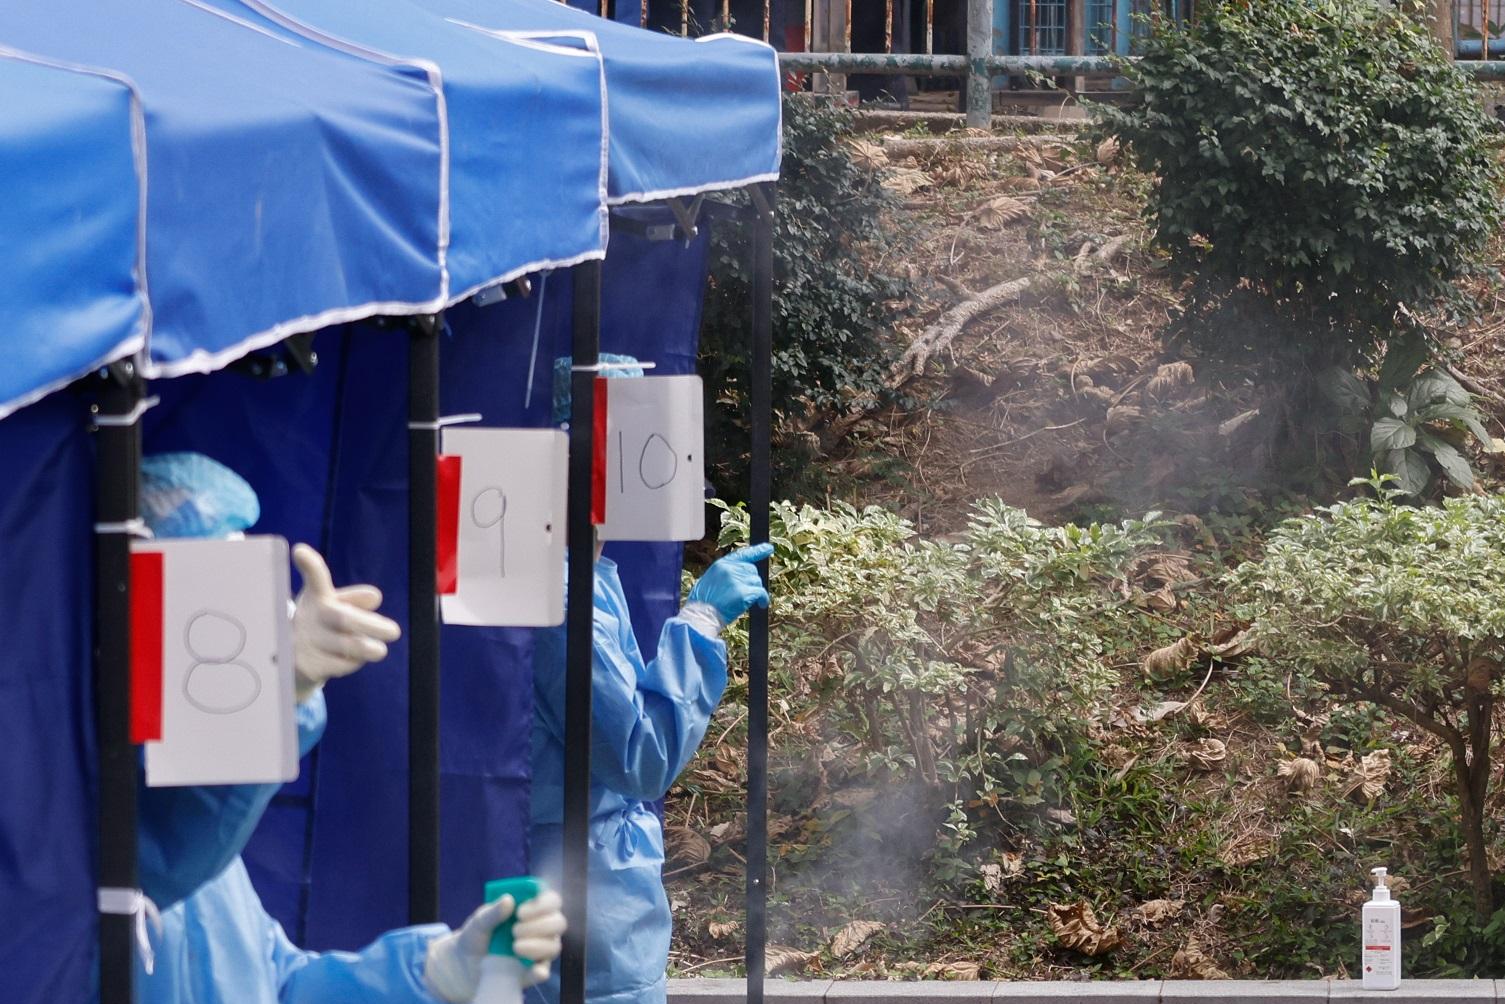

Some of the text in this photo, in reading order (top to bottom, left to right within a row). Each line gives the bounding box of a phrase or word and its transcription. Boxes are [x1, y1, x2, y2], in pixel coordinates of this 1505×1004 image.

[618, 430, 678, 494] 10
[471, 486, 507, 578] 9
[182, 608, 262, 715] 8
